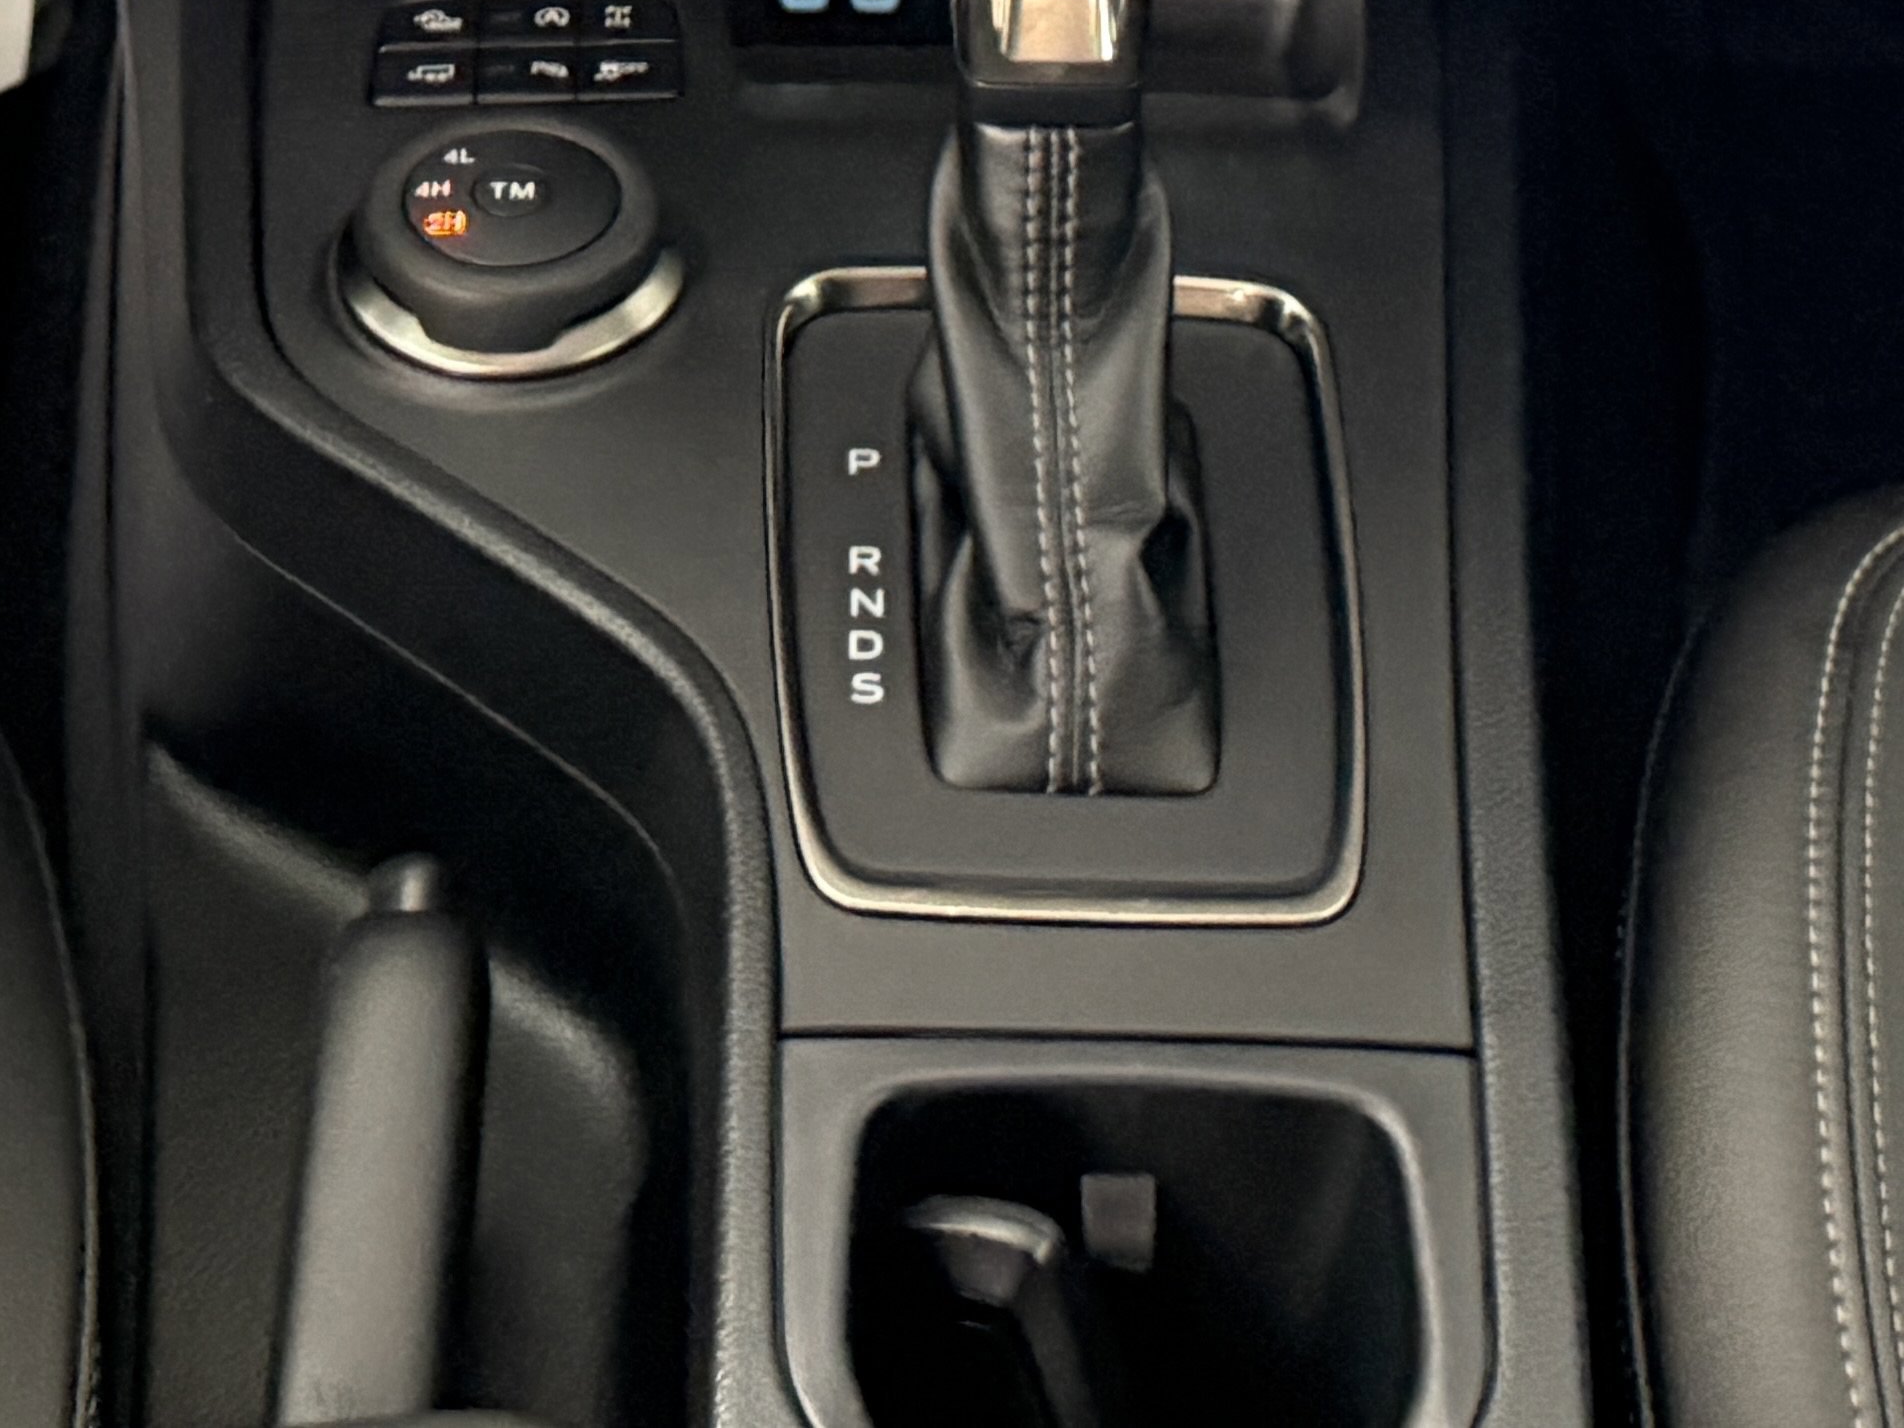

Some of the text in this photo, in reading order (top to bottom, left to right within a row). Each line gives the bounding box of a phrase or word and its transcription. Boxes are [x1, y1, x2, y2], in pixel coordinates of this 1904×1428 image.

[443, 147, 476, 166] 4L
[413, 179, 452, 198] 4H
[489, 180, 537, 200] TM
[848, 447, 882, 476] P
[848, 545, 883, 576] R
[849, 587, 886, 619] N
[848, 630, 884, 661] D
[850, 672, 885, 705] S
